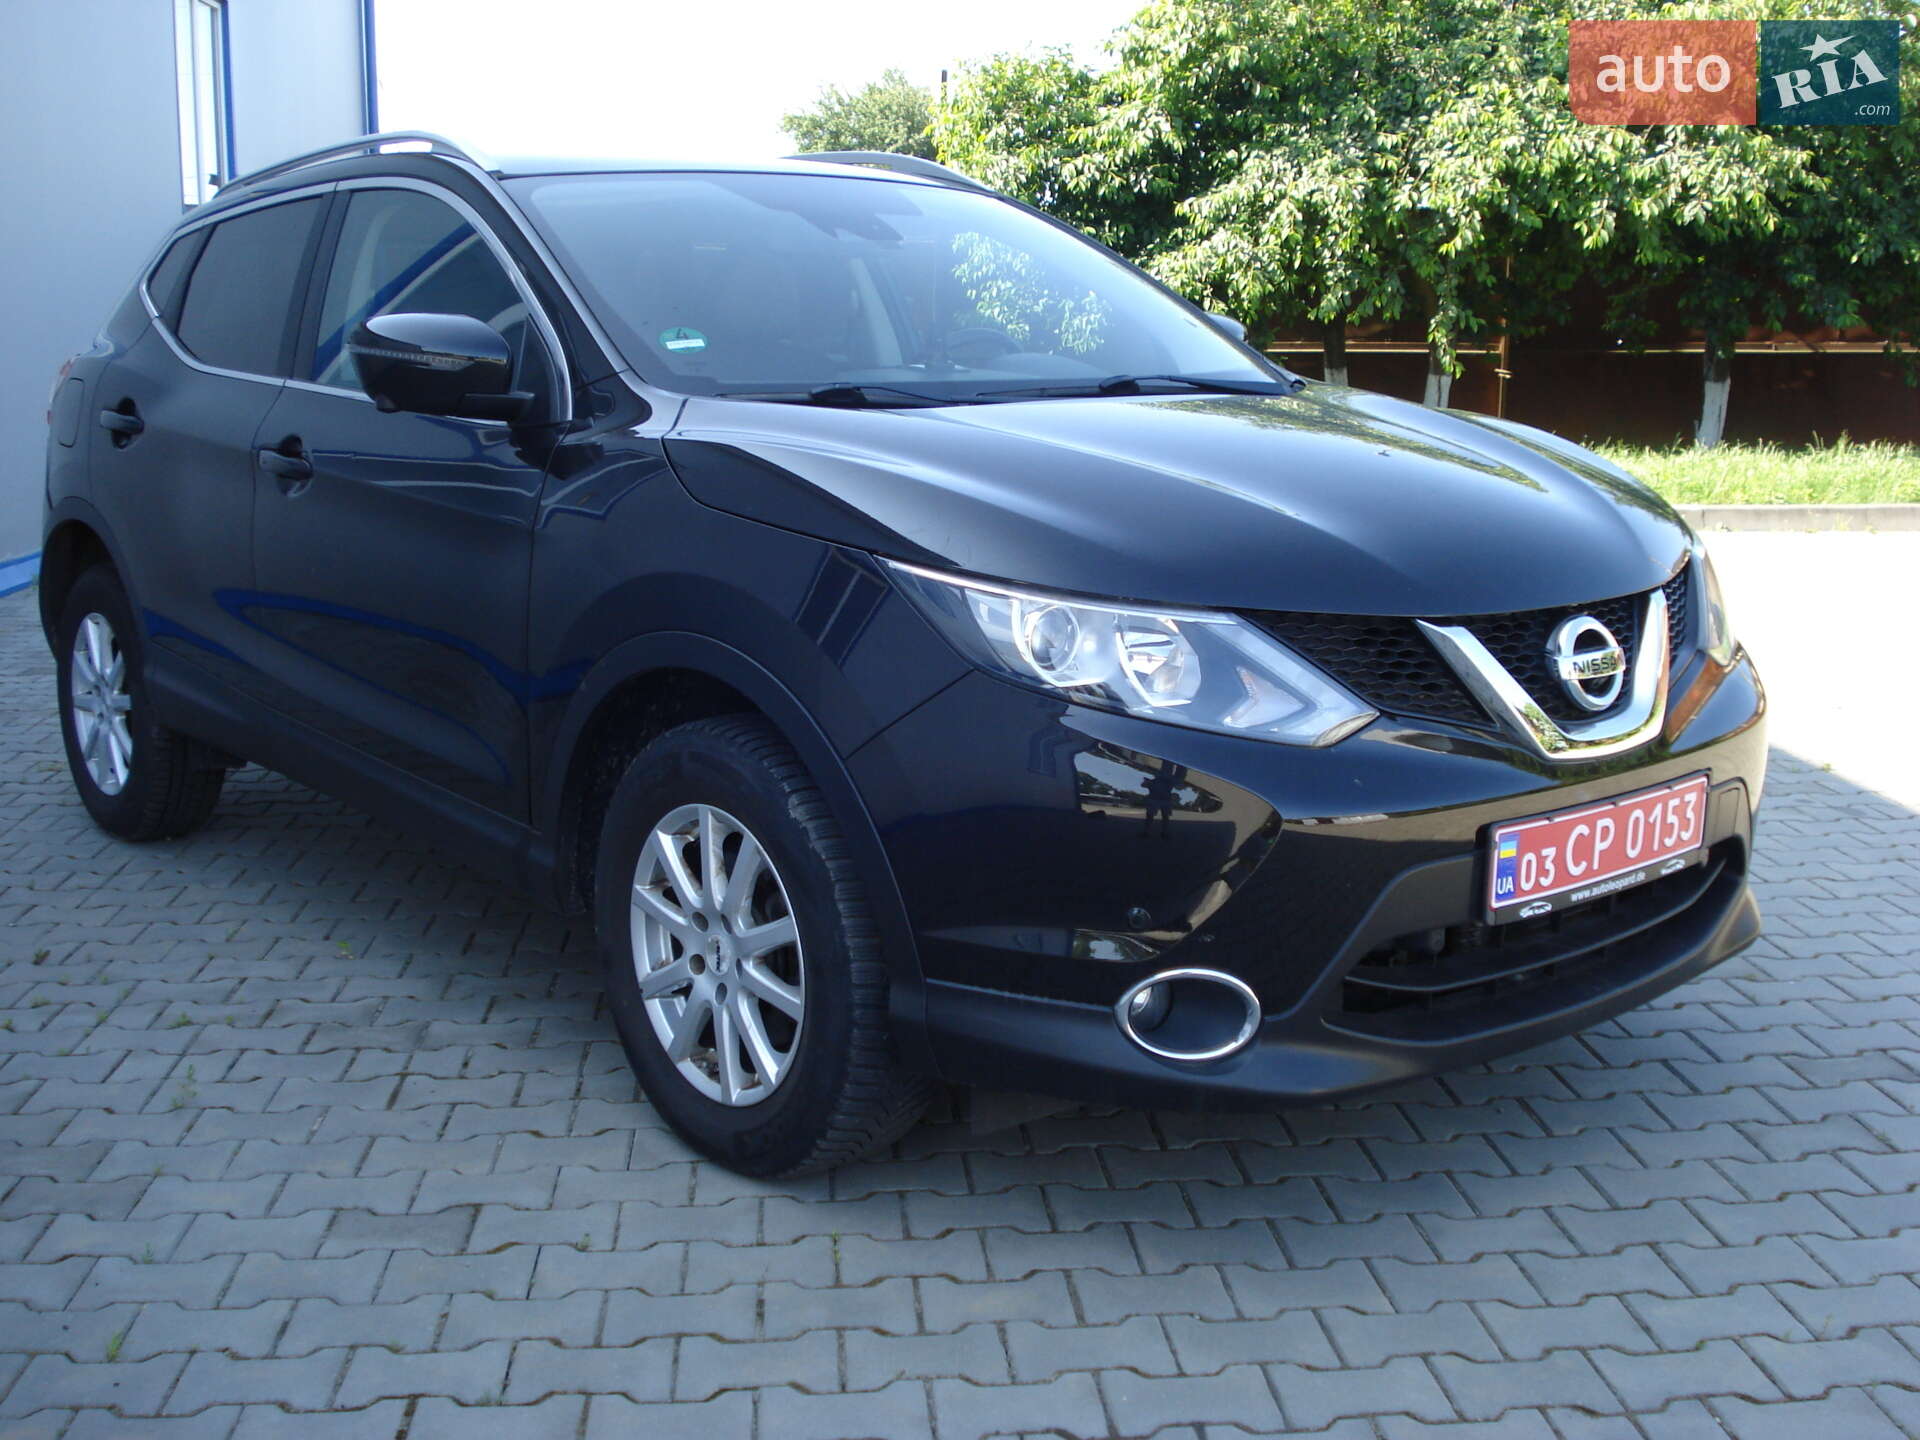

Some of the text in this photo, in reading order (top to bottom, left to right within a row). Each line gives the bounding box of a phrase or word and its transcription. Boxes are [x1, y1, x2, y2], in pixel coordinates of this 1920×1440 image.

[1572, 656, 1618, 673] NISSA
[1520, 791, 1698, 891] 03 CP 0153
[1497, 876, 1514, 894] UA
